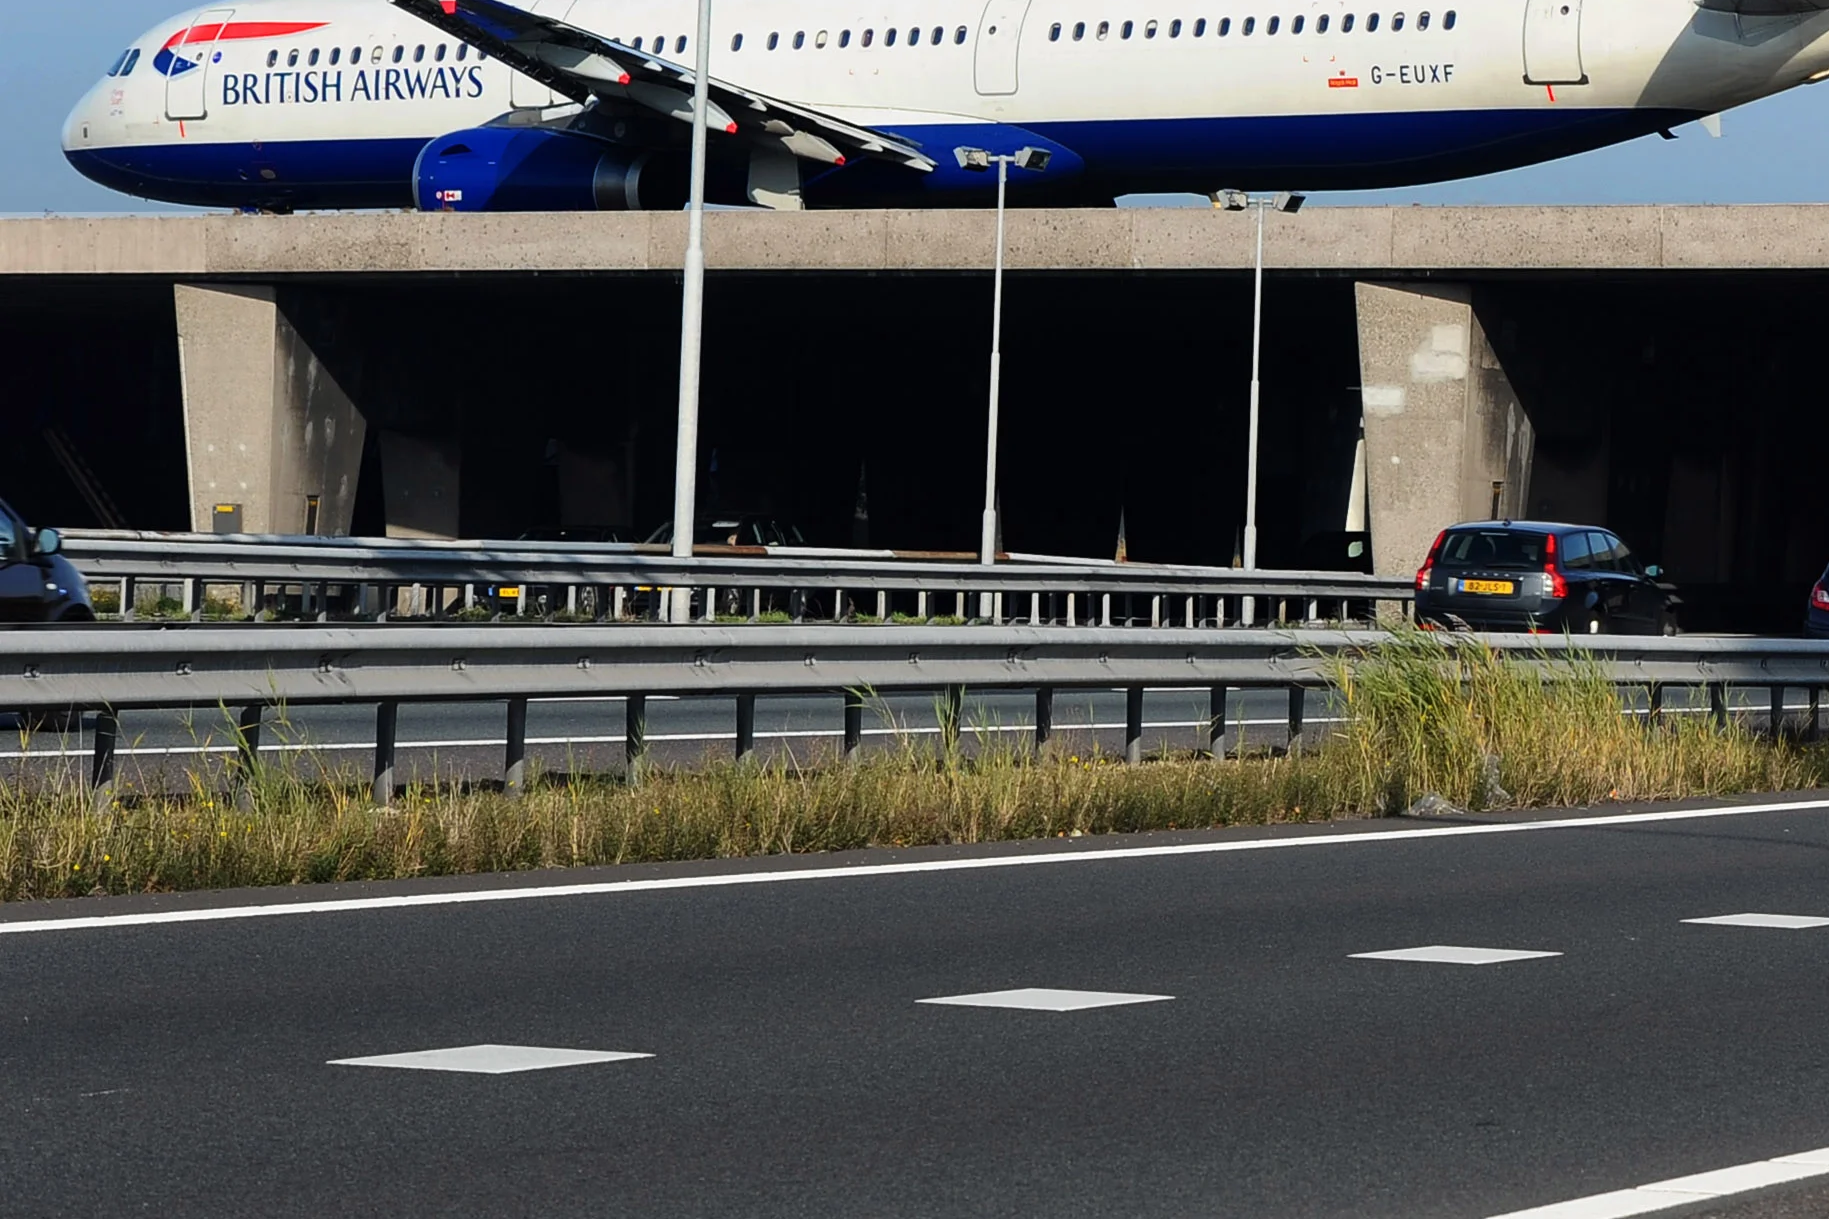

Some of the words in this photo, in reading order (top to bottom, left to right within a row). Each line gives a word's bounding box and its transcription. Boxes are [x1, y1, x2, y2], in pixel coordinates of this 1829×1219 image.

[223, 68, 342, 105] BRITISH
[350, 64, 483, 101] AIRWAYS
[1371, 64, 1454, 85] G-EUXF
